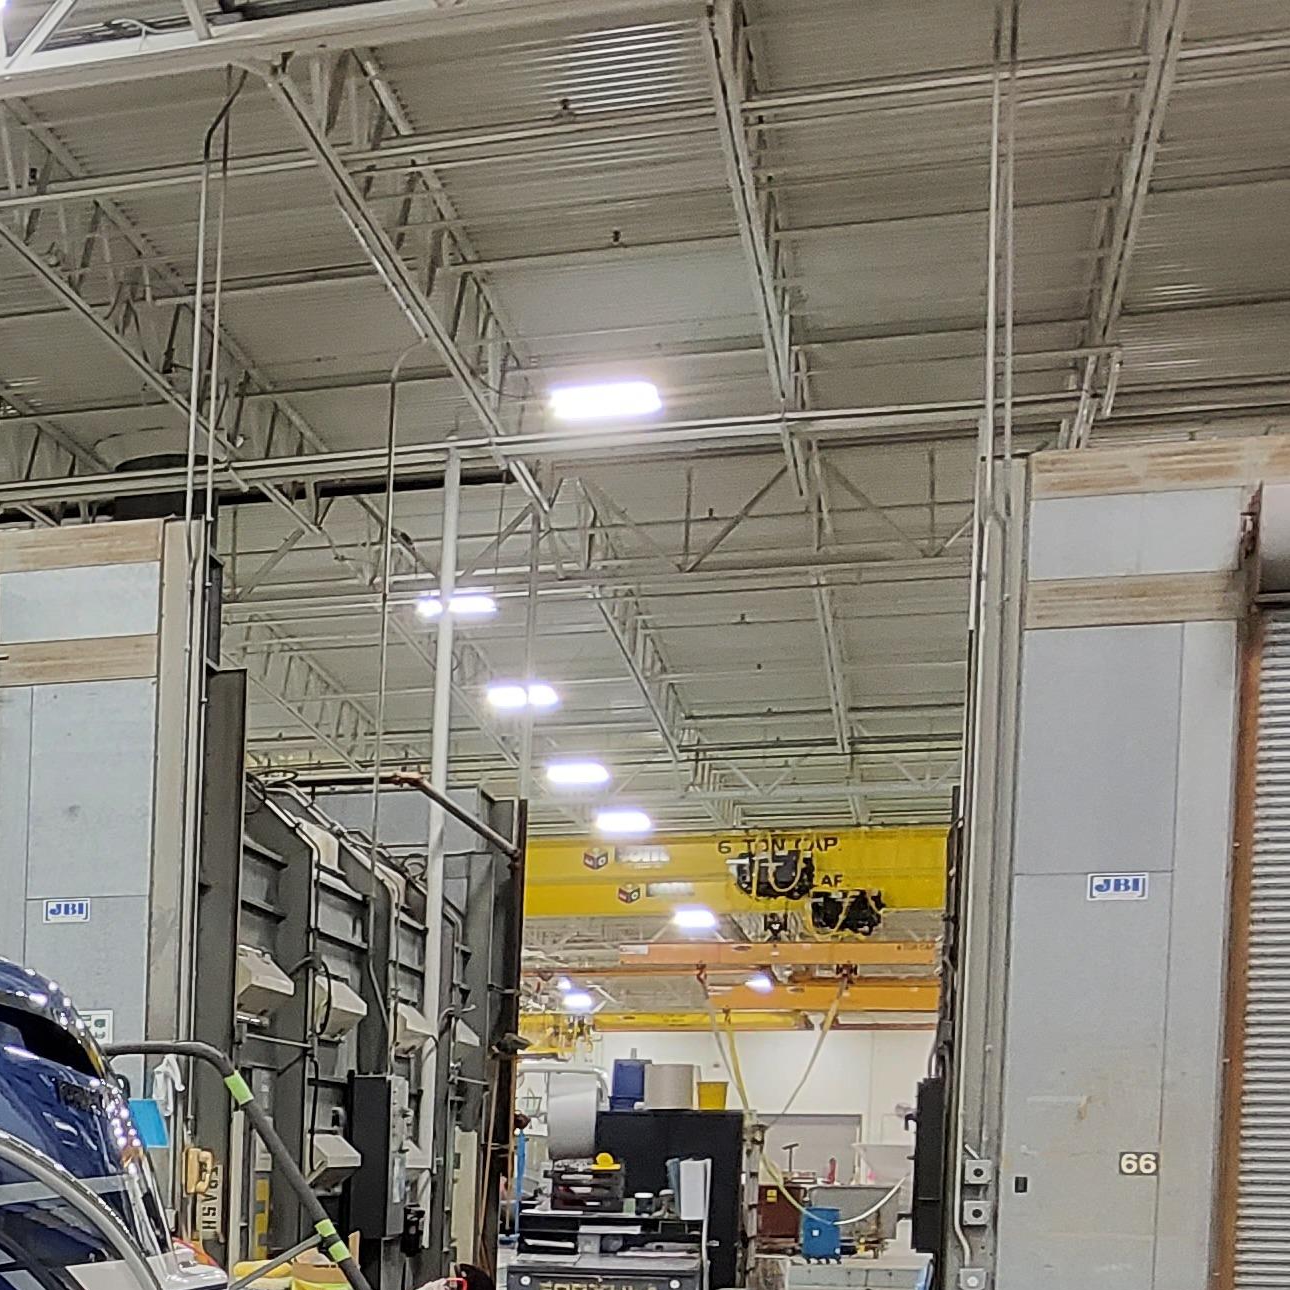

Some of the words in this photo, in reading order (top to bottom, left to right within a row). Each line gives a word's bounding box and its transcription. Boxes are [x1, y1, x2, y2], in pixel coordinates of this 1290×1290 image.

[1094, 877, 1140, 892] JBI
[49, 902, 84, 915] JBI
[1120, 1153, 1157, 1174] 66
